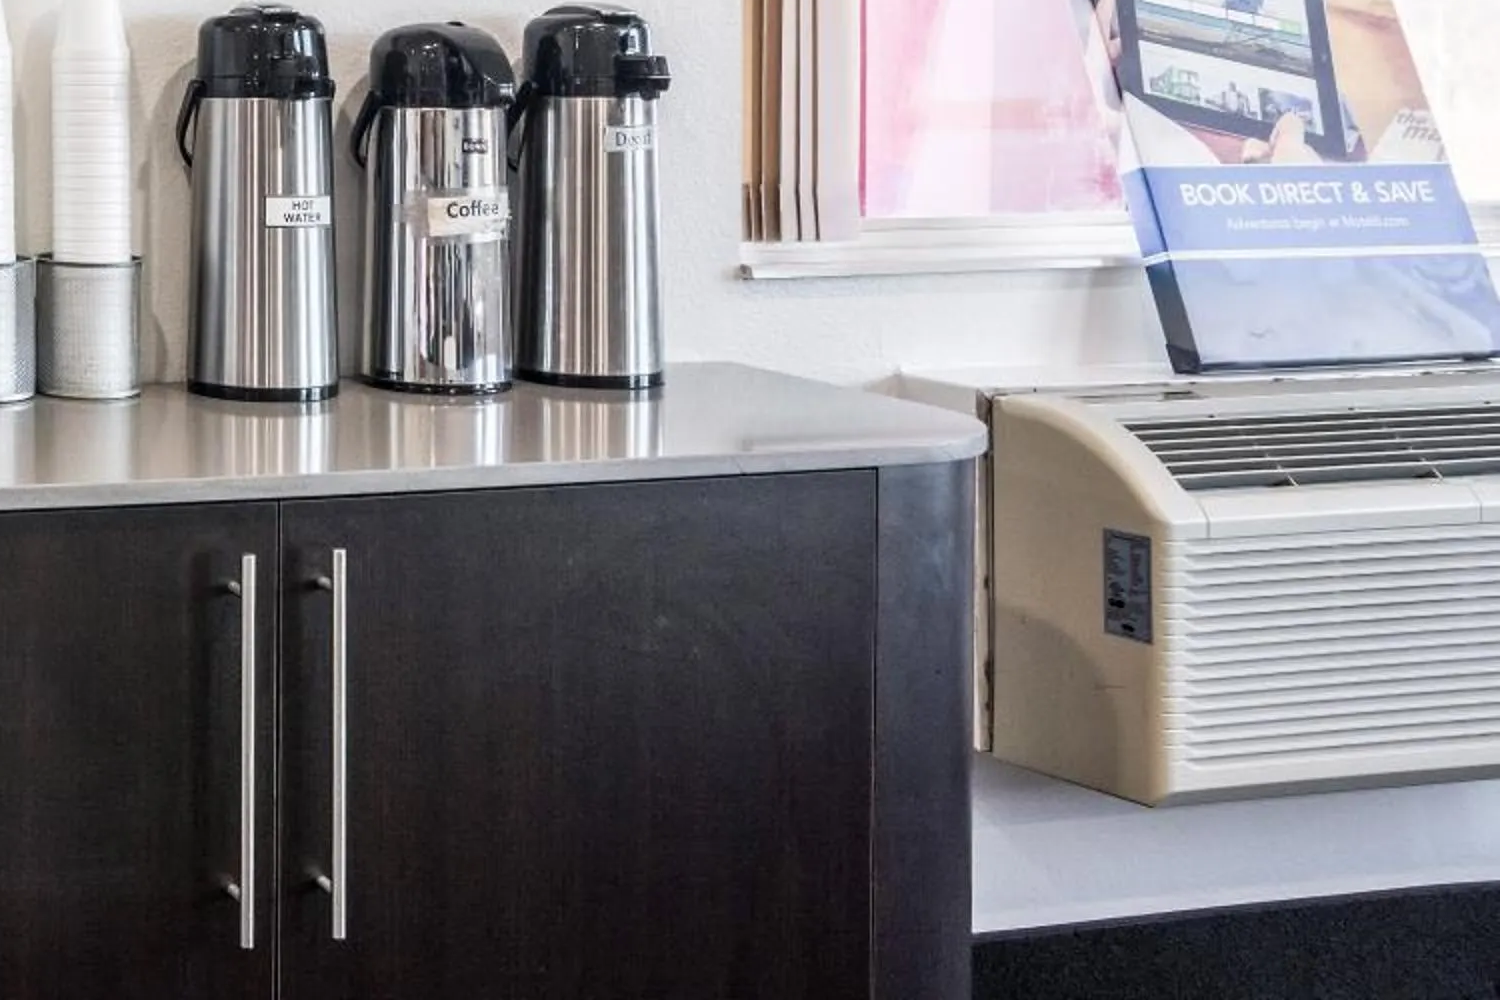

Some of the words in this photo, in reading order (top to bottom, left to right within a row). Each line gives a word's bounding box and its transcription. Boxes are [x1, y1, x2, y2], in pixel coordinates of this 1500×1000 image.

[1179, 183, 1255, 206] BOOK
[1258, 181, 1344, 206] DIRECT
[1350, 181, 1371, 204] &
[1373, 180, 1436, 203] SAVE
[283, 212, 322, 223] WATER
[446, 200, 500, 218] Coffee
